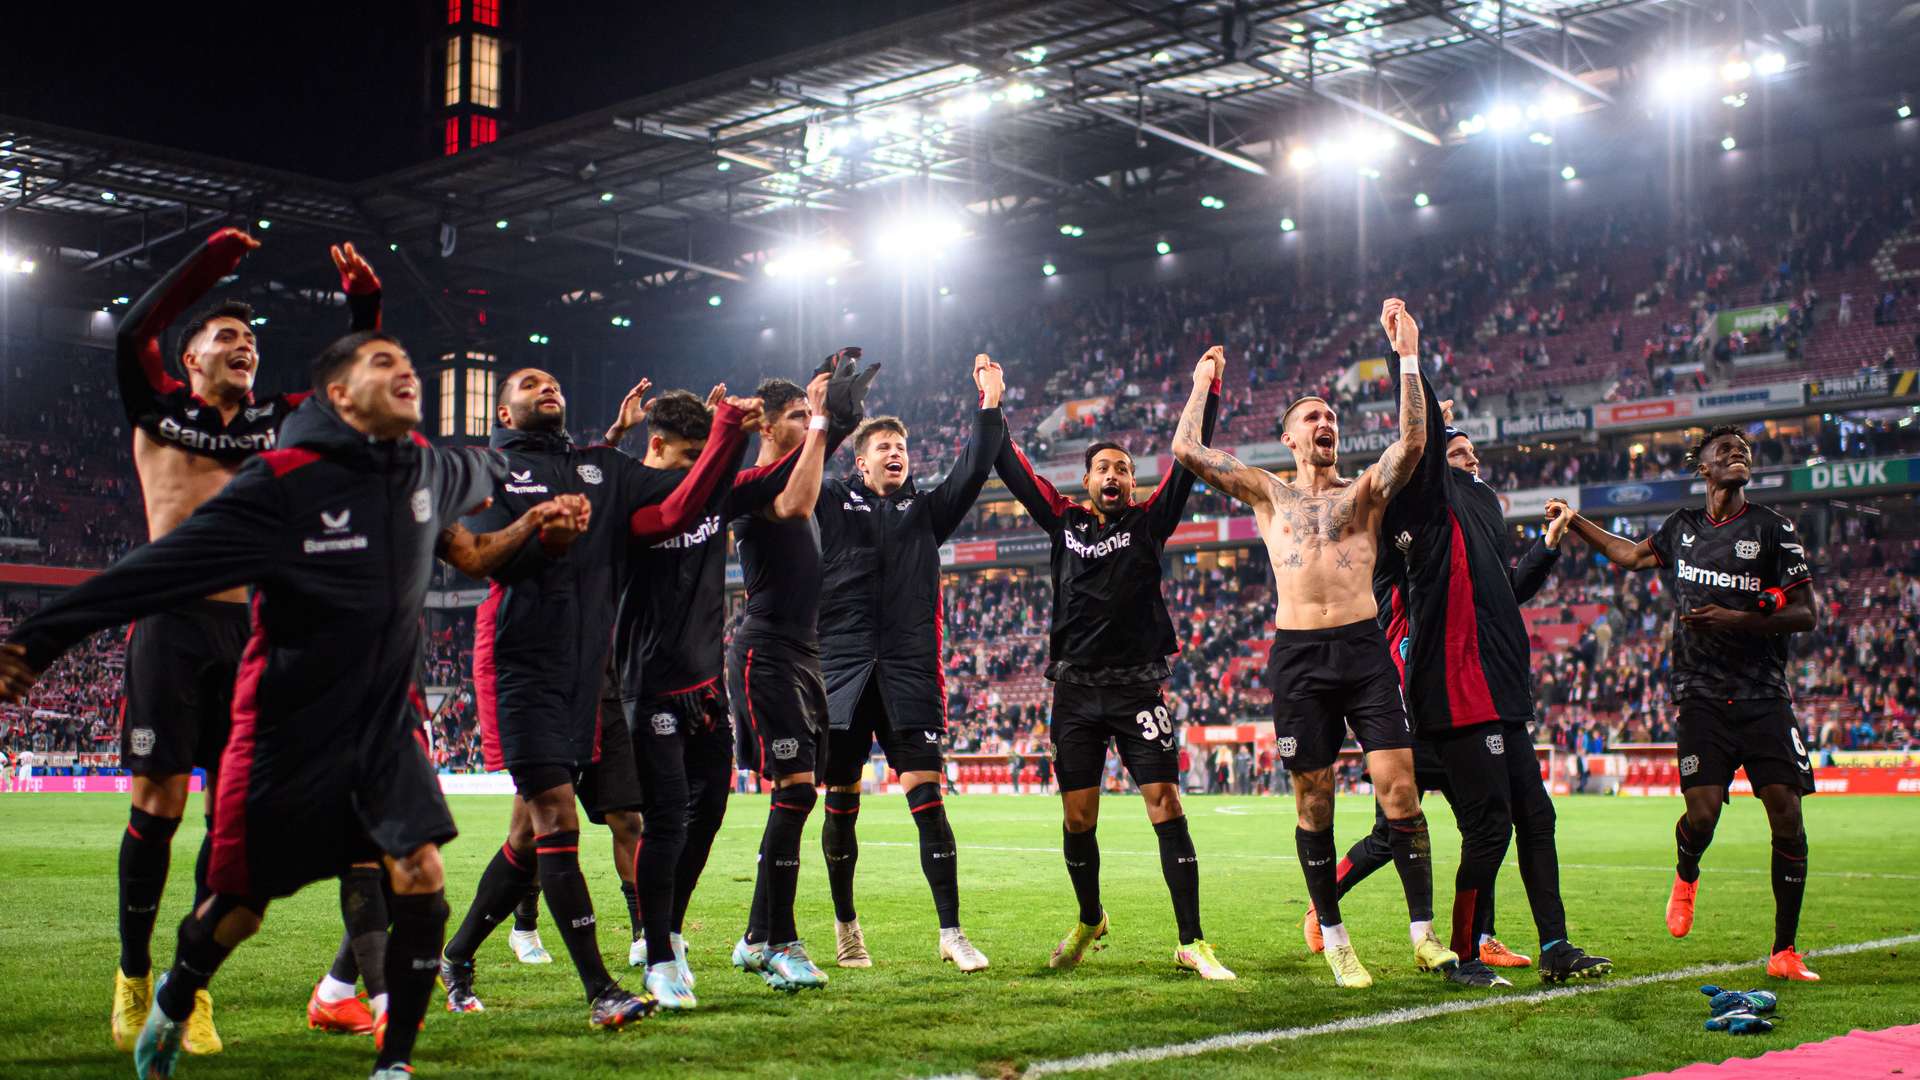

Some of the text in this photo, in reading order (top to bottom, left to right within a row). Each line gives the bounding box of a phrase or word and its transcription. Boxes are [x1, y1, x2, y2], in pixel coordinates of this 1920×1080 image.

[158, 416, 276, 450] Barmeni
[1341, 431, 1401, 452] UWENS
[1811, 460, 1888, 489] DEVK
[1677, 559, 1761, 592] Barmenia
[1136, 706, 1173, 740] 38
[1815, 778, 1848, 792] EWE
[1897, 778, 1920, 792] RE
